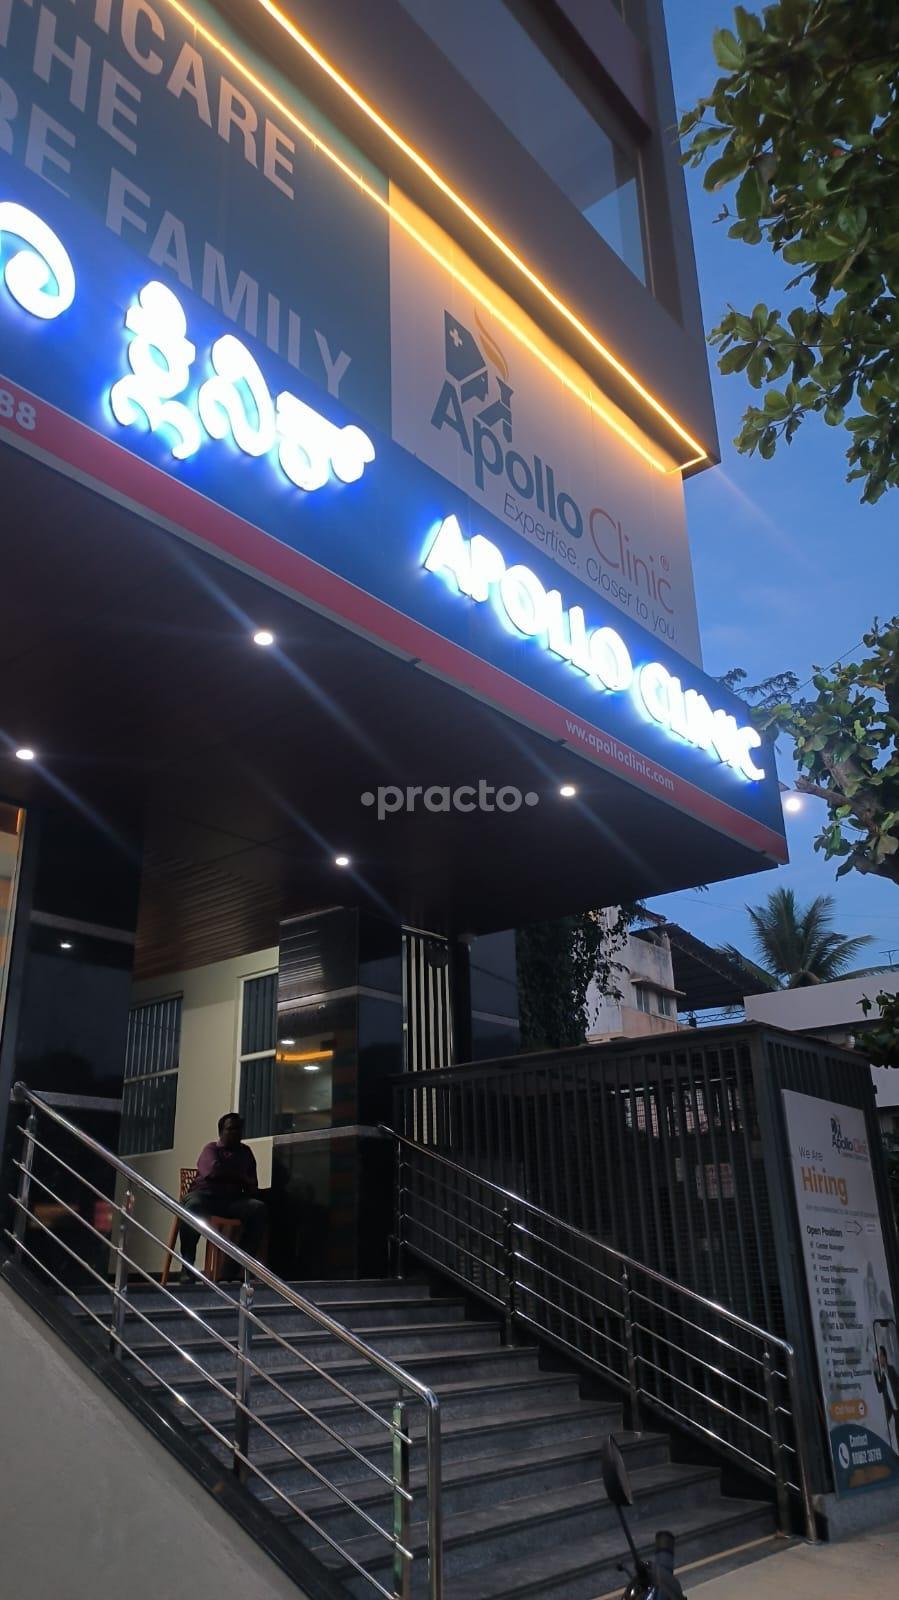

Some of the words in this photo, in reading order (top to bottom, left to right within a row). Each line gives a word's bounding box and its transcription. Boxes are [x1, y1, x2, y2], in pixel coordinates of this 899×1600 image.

[22, 0, 297, 201] CARE
[105, 167, 353, 398] FAMILY
[431, 379, 584, 540] Apollo
[503, 492, 580, 569] Expertise.
[586, 558, 634, 604] Closer
[635, 596, 649, 619] to
[652, 610, 676, 642] you
[423, 513, 633, 693] APOLLO
[635, 661, 765, 782] CLINIC
[799, 1145, 811, 1160] We
[800, 1166, 849, 1205] Hiring
[806, 1225, 821, 1238] Open
[849, 1434, 869, 1448] Contact
